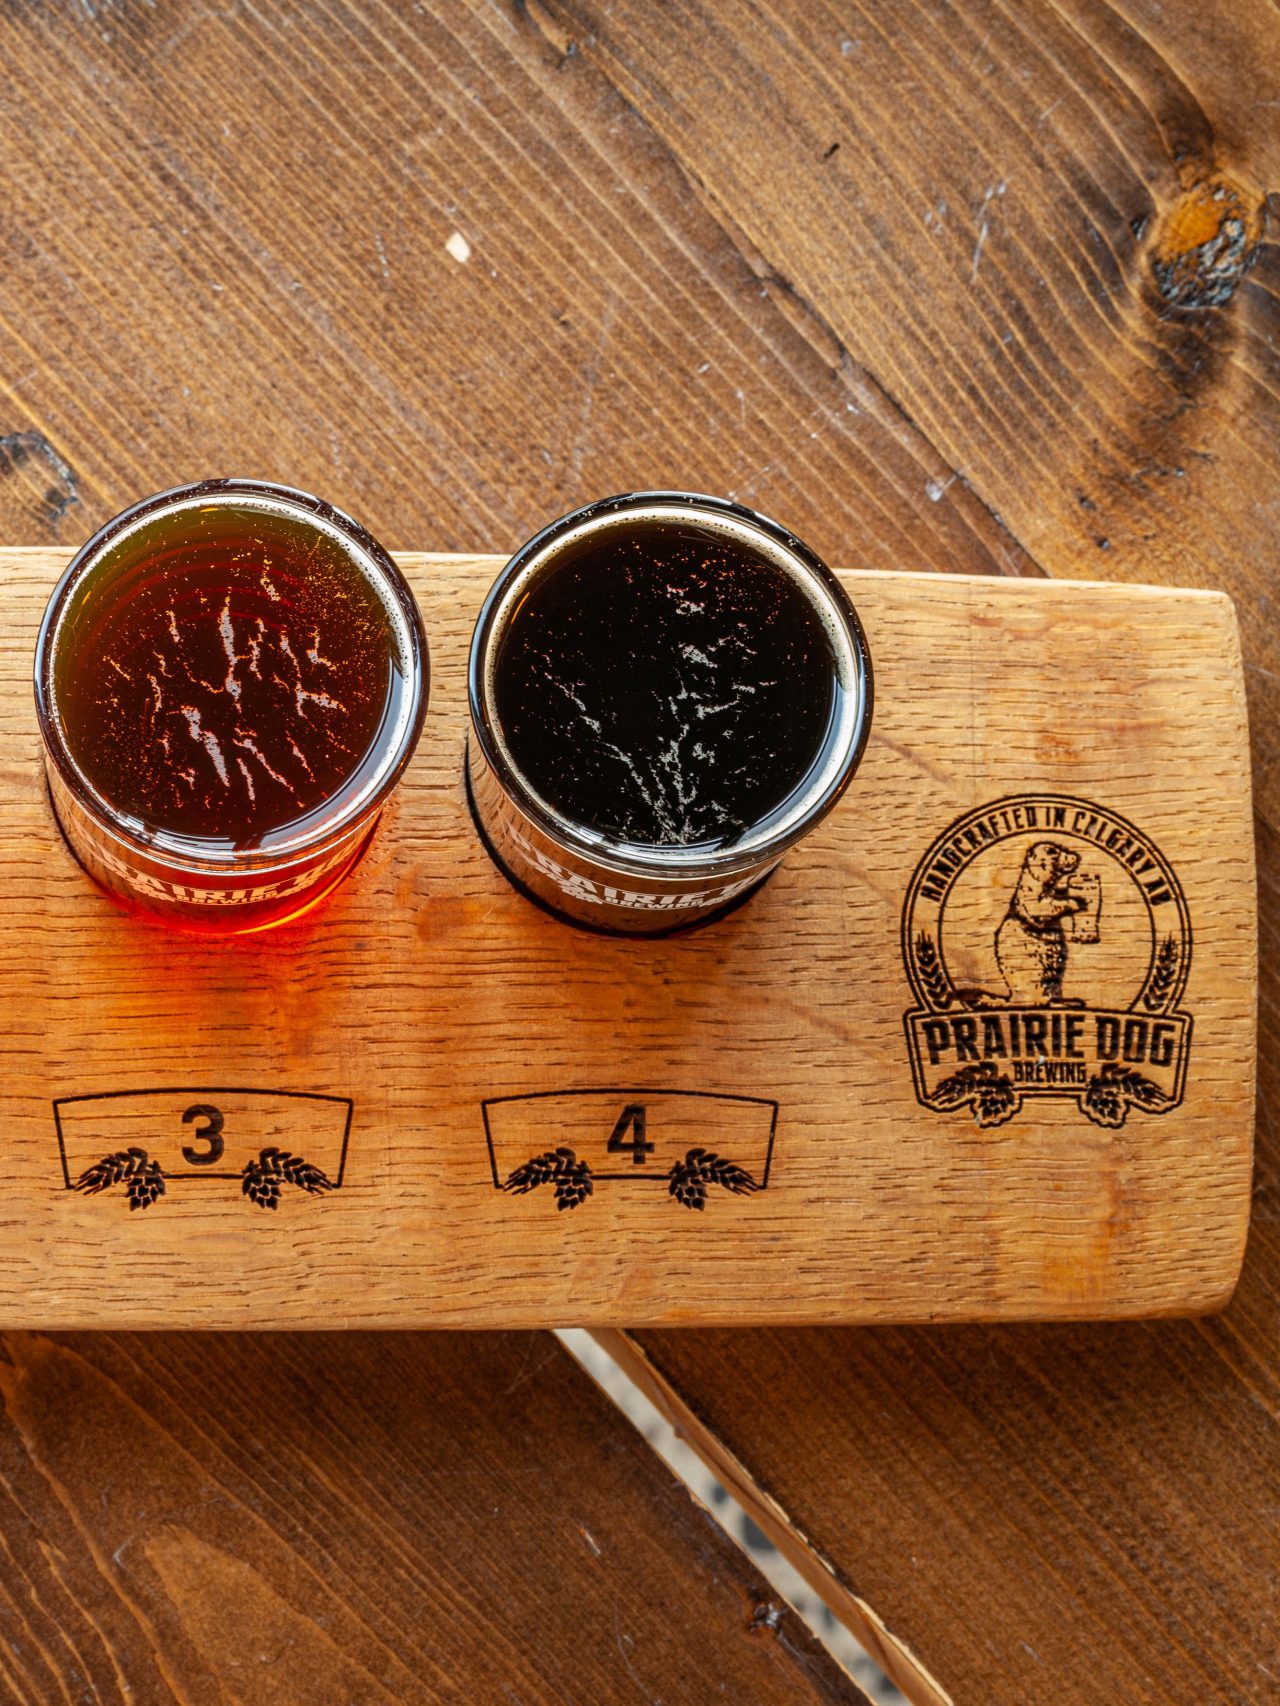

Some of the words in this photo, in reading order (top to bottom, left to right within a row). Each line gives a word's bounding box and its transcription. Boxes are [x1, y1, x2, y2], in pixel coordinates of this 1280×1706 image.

[920, 807, 1036, 903] HANDCRAFTED
[1045, 807, 1065, 827] IN
[1073, 810, 1157, 876] CALGARY
[1144, 876, 1172, 905] AB
[922, 1013, 1086, 1065] PRAIRIE
[1096, 1015, 1176, 1067] DOG
[1012, 1061, 1086, 1083] BREWING
[182, 1103, 224, 1166] 3
[608, 1104, 655, 1166] 4
